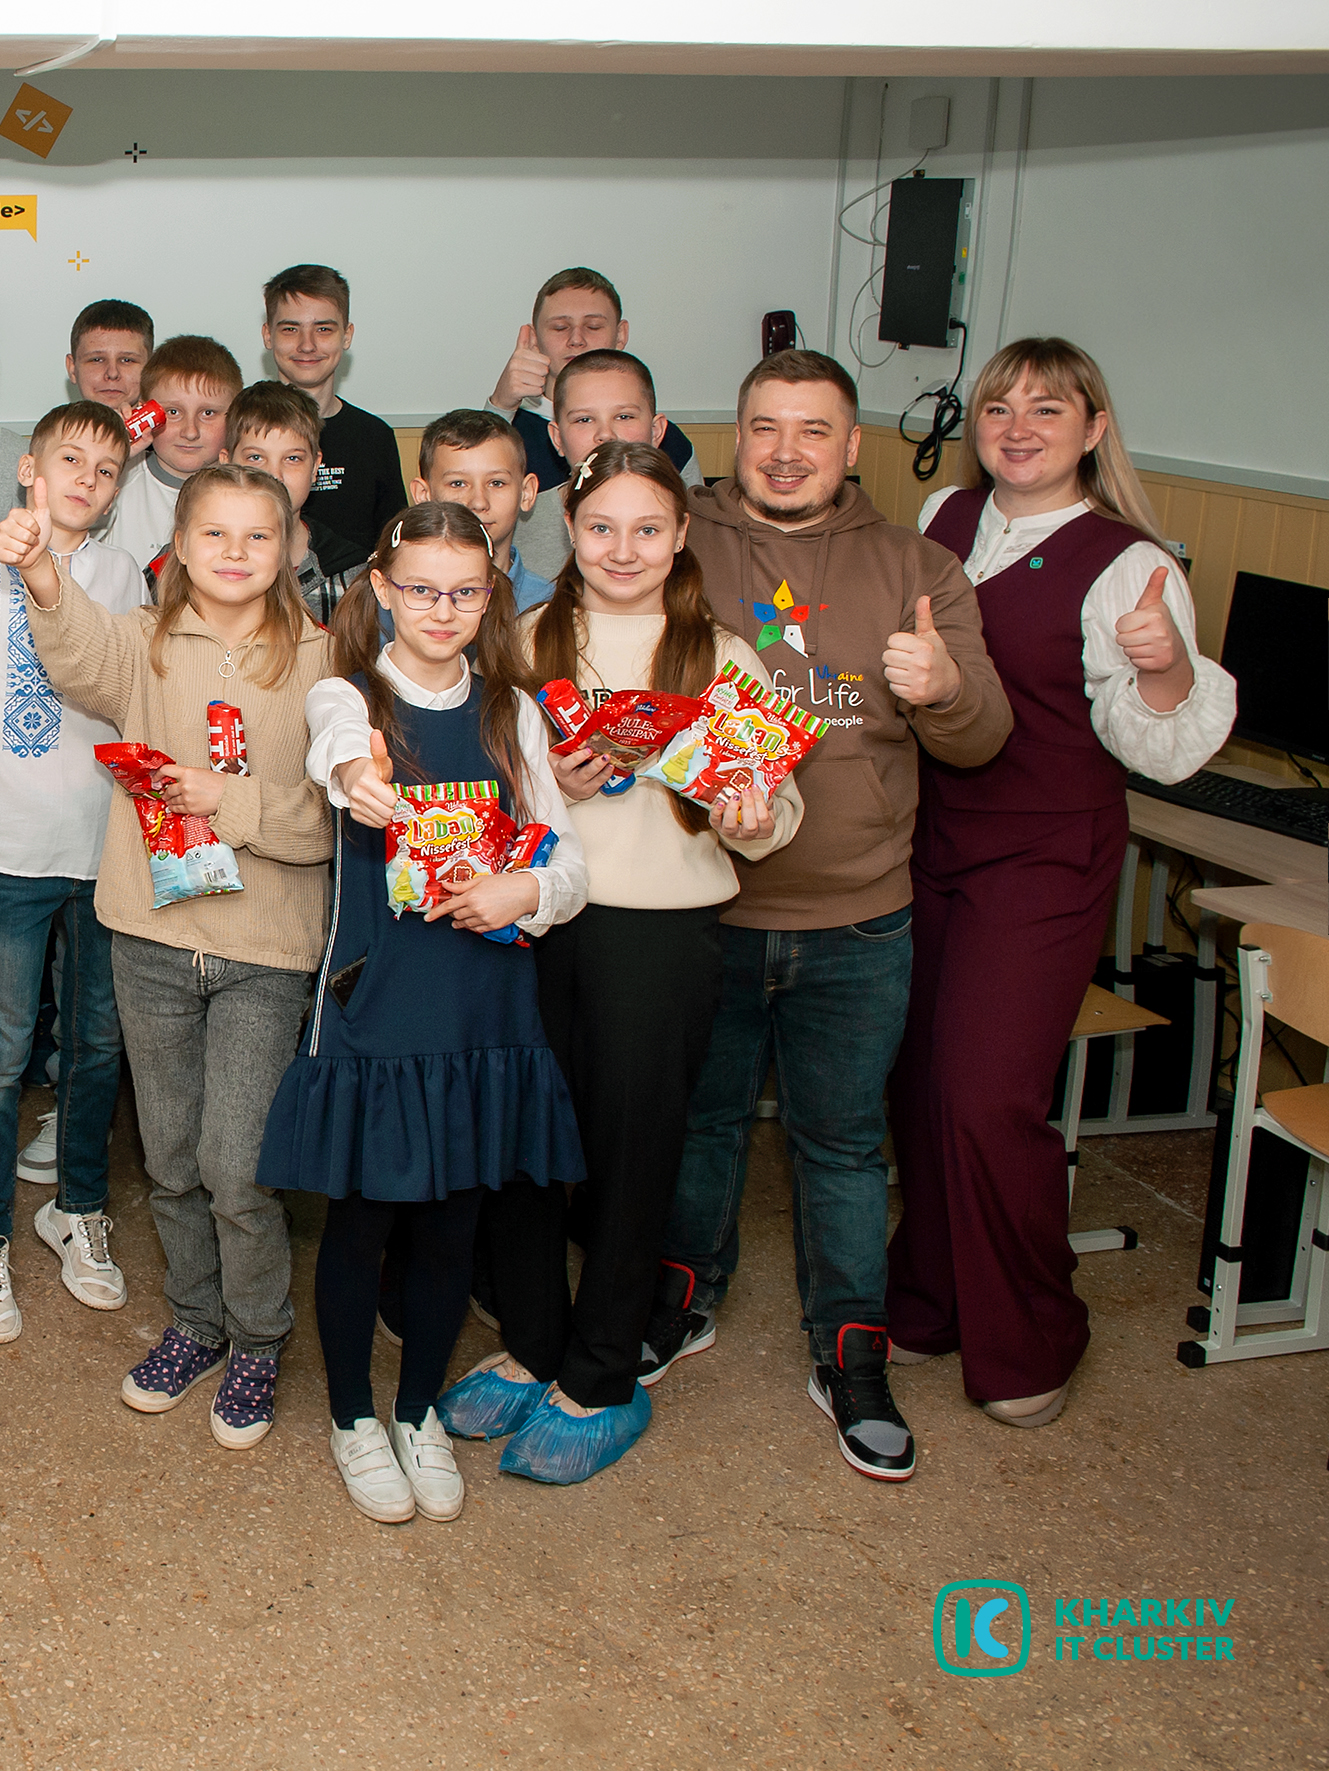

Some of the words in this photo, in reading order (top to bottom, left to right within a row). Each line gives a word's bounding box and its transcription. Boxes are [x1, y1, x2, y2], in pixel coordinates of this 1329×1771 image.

[815, 664, 864, 682] Ukraine
[773, 669, 804, 703] for
[808, 668, 865, 710] Life
[602, 723, 663, 740] MARSIPAN
[713, 711, 791, 757] Labans
[715, 736, 768, 764] Nissefest
[412, 815, 485, 843] Labans
[420, 835, 473, 857] Nissefest
